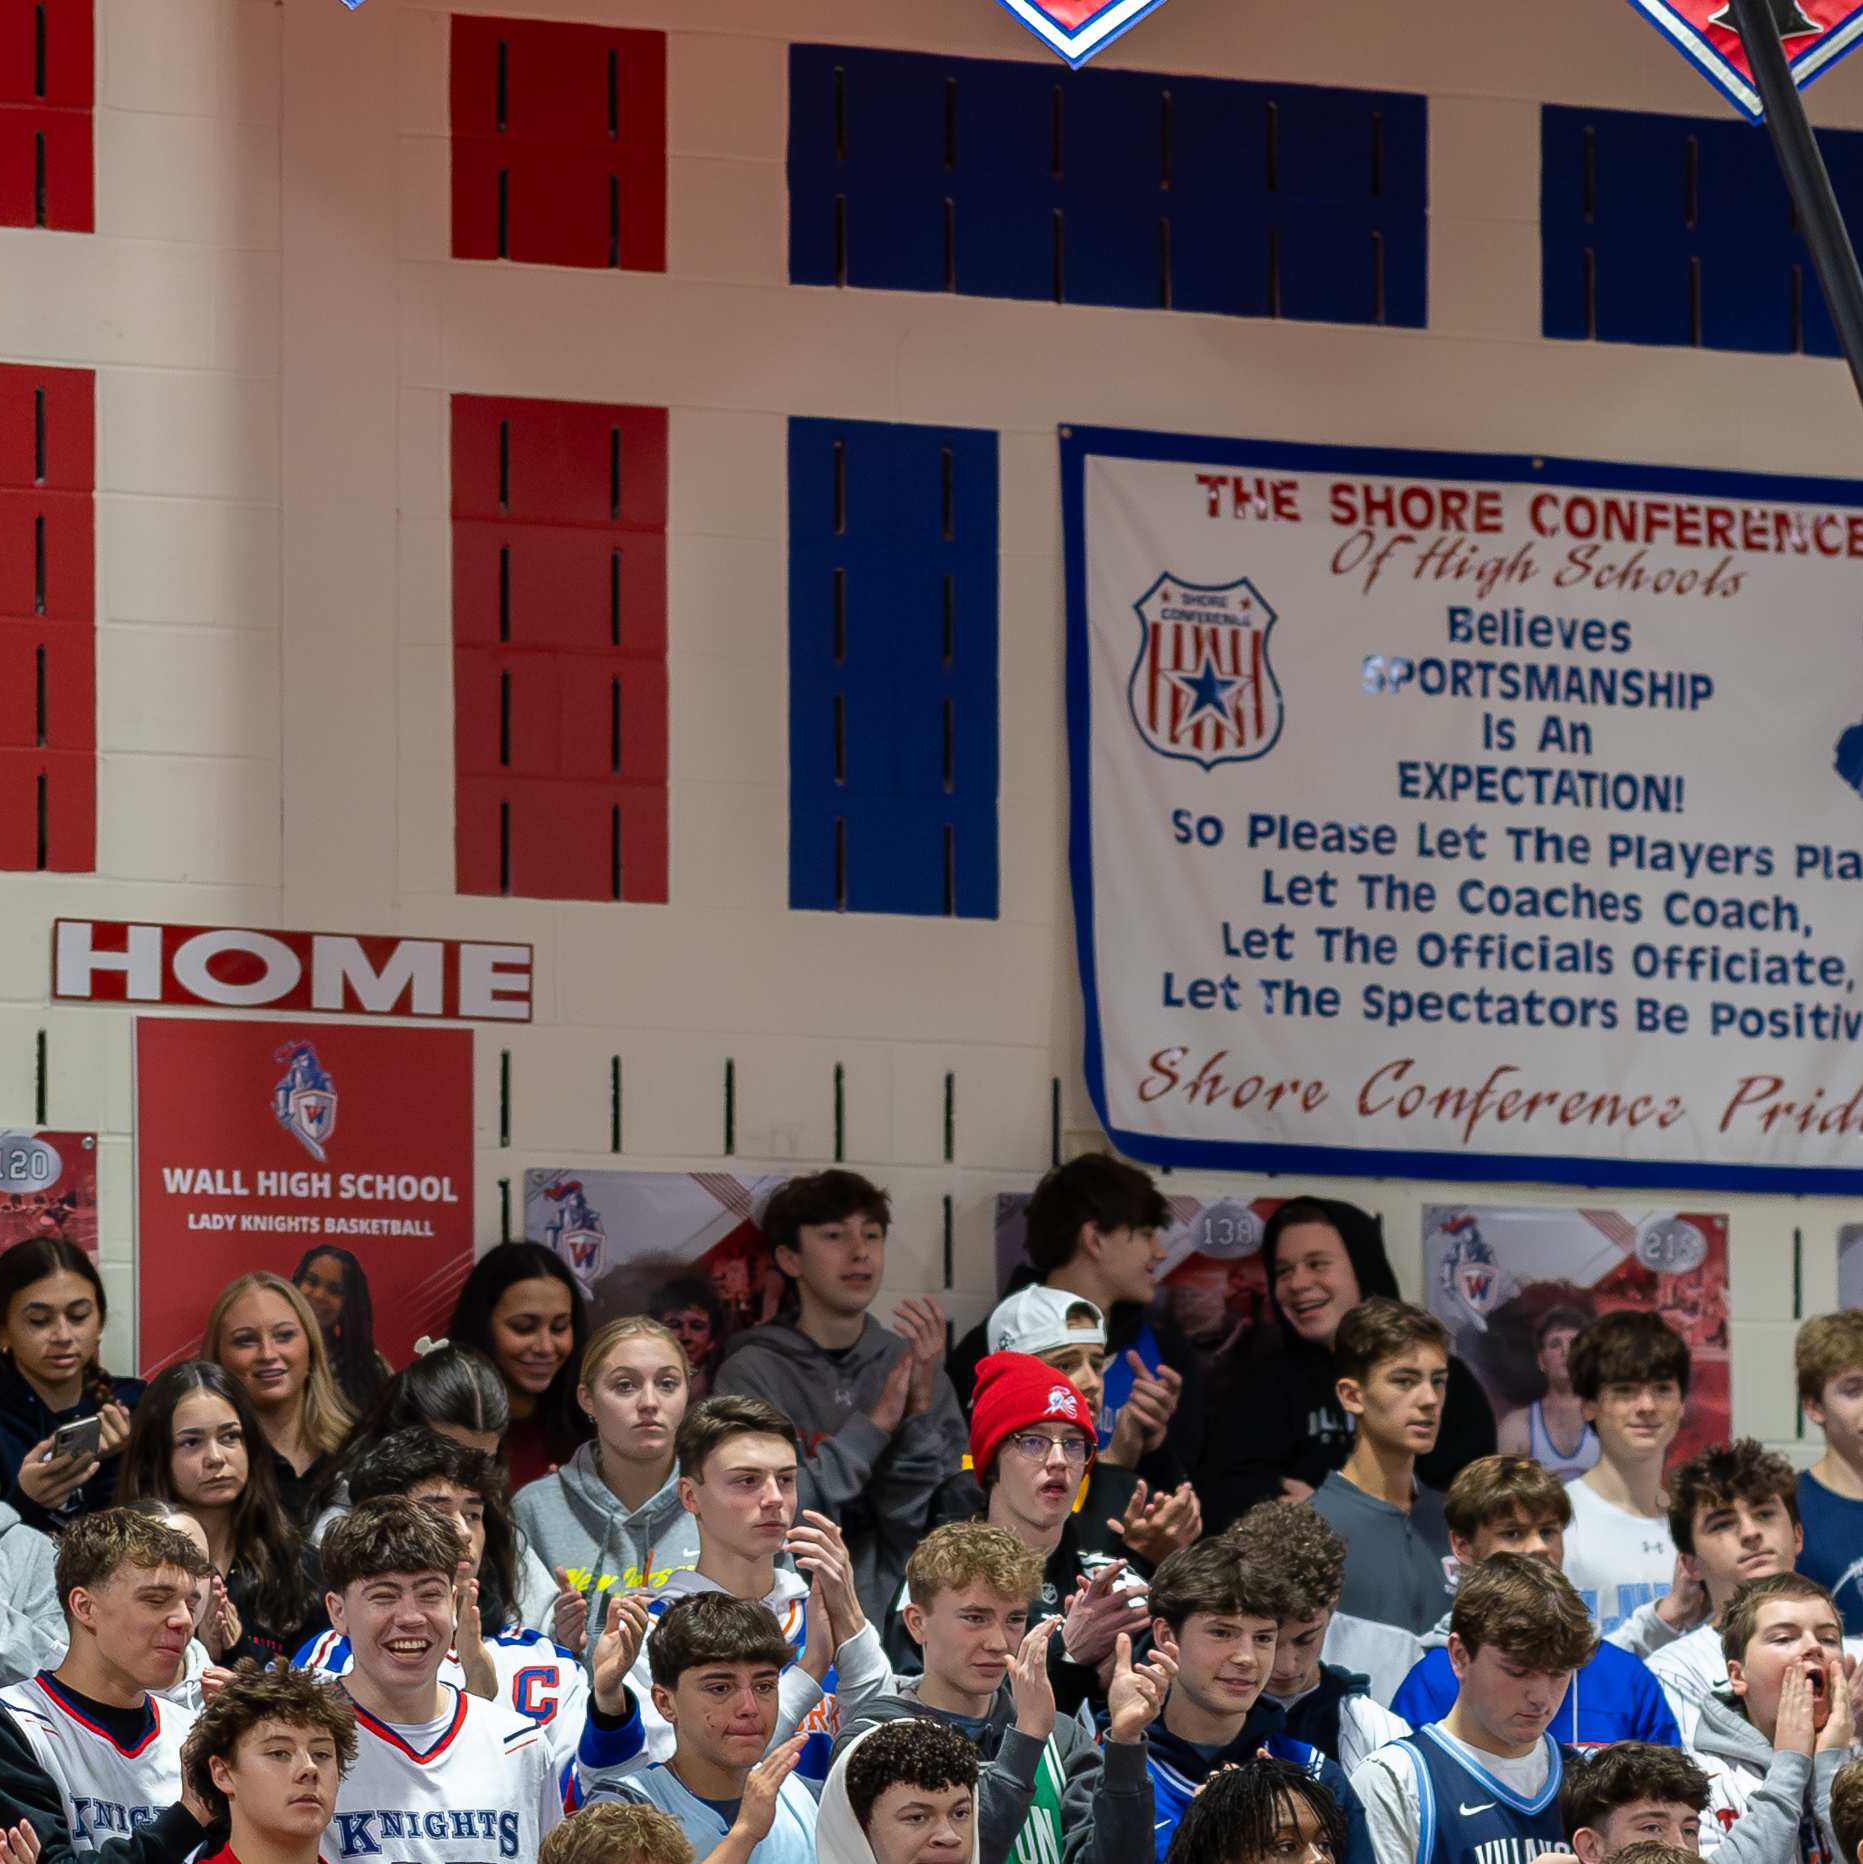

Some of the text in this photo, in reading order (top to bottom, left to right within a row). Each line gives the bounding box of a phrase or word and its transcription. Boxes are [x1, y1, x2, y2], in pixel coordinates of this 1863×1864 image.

[1196, 473, 1301, 522] THE
[1330, 482, 1503, 533] SHORE
[1330, 529, 1749, 600] Of High Schools
[1447, 606, 1631, 652] Believes
[1362, 654, 1713, 710] SPORTSMANSHIP
[1482, 712, 1592, 756] Is An
[1398, 760, 1684, 813] EXPECTATION!
[1172, 808, 1224, 847] So
[1247, 812, 1397, 856] Please
[1417, 821, 1487, 861] Let
[1506, 827, 1591, 866] The
[1608, 832, 1774, 878] Players
[1263, 868, 1813, 938] Let The Coaches Coach,
[56, 922, 531, 1017] HOME
[1222, 921, 1855, 994] Let The Officials Officiate,
[1162, 971, 1240, 1012] Let
[1255, 977, 1341, 1018] The
[1362, 983, 1619, 1028] Spectators
[1635, 997, 1689, 1034] Be
[1137, 1045, 1329, 1114] Shore
[1356, 1057, 1686, 1145] Conference
[163, 1168, 459, 1203] WALL HIGH SCHOOL
[188, 1213, 435, 1237] LADY KNIGHTS BASKETBALL
[1200, 1216, 1255, 1248] 138
[513, 1666, 560, 1726] C
[334, 1809, 520, 1860] KNIGHTS
